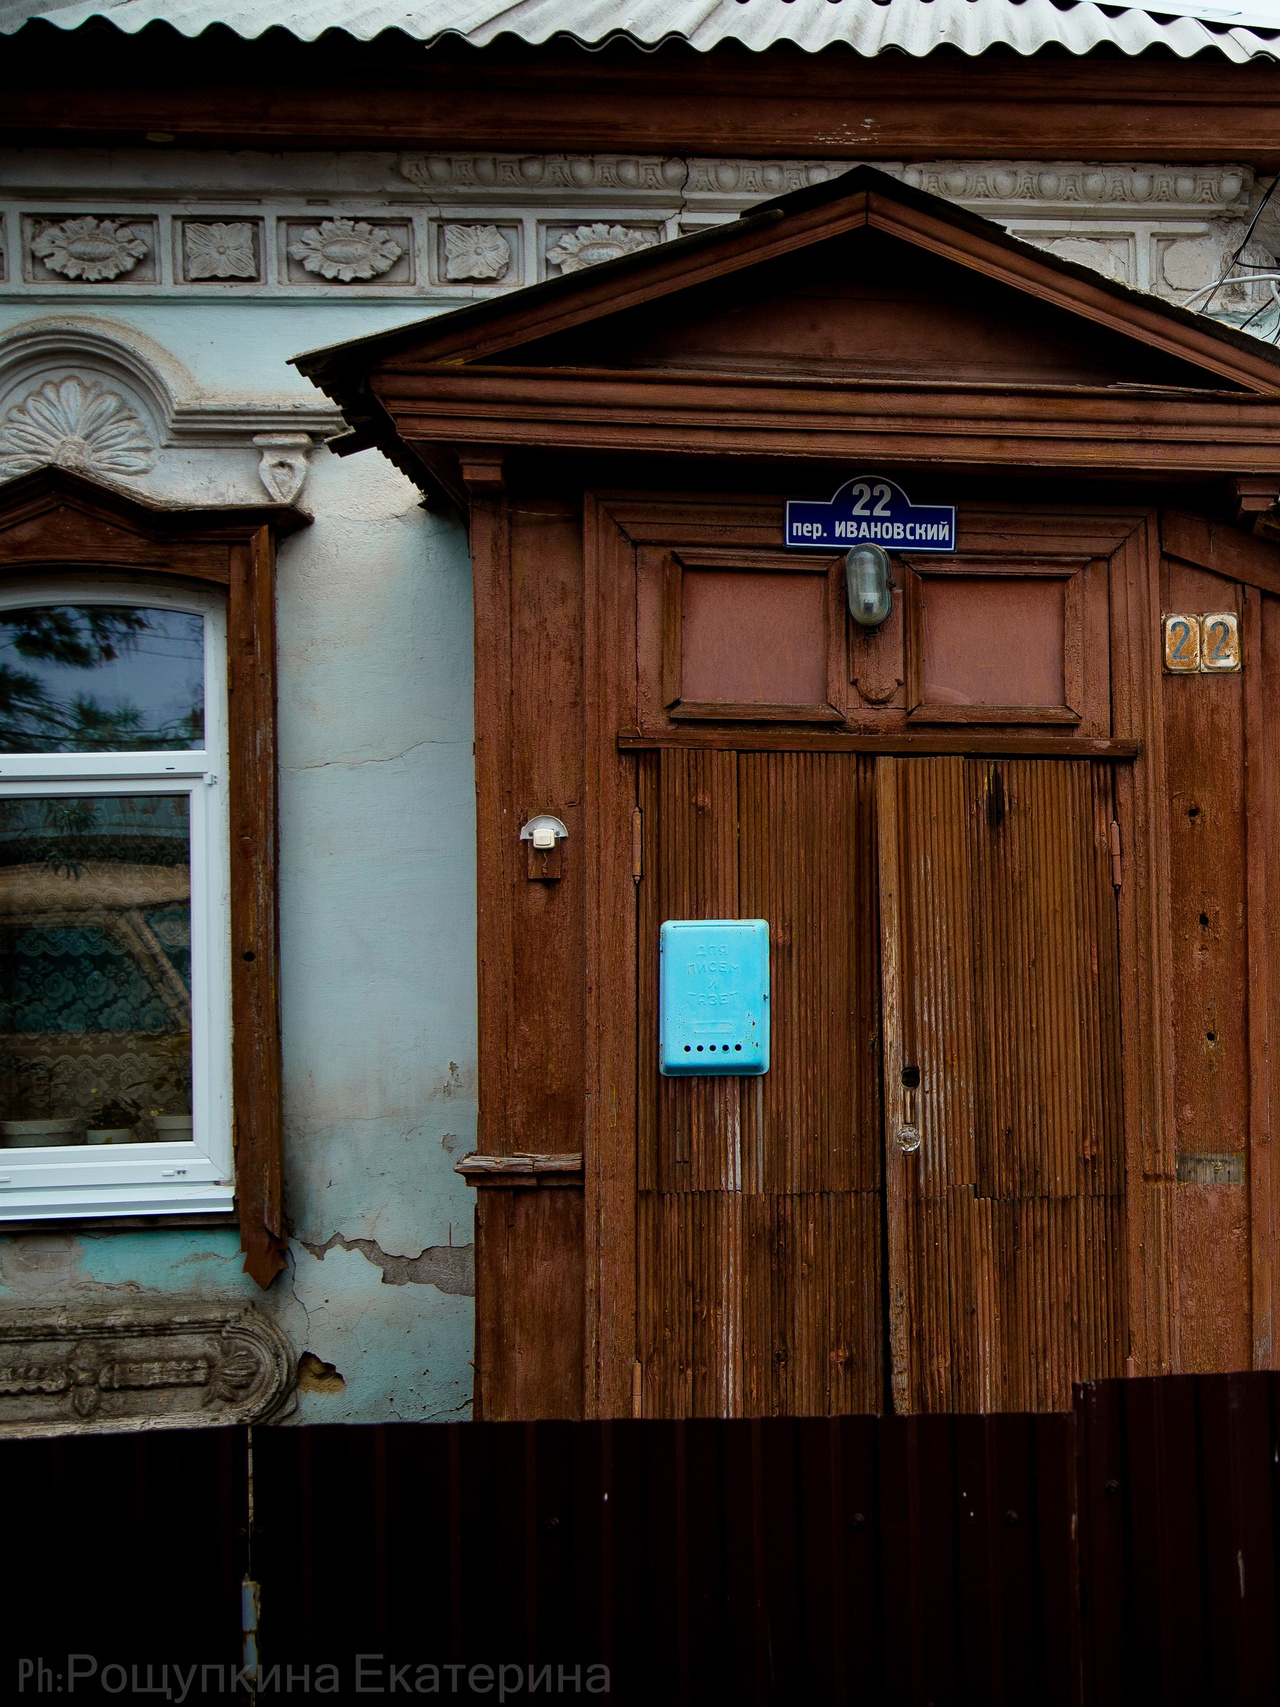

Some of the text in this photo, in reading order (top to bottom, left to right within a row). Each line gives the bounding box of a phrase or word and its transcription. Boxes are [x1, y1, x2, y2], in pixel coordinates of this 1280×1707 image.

[852, 483, 892, 517] 22
[792, 521, 950, 541] пер. ИВАНОВСКИЙ
[1170, 621, 1231, 661] 22
[686, 961, 741, 974] ПИСЕМ
[688, 992, 739, 1006] ГАЗЕТ
